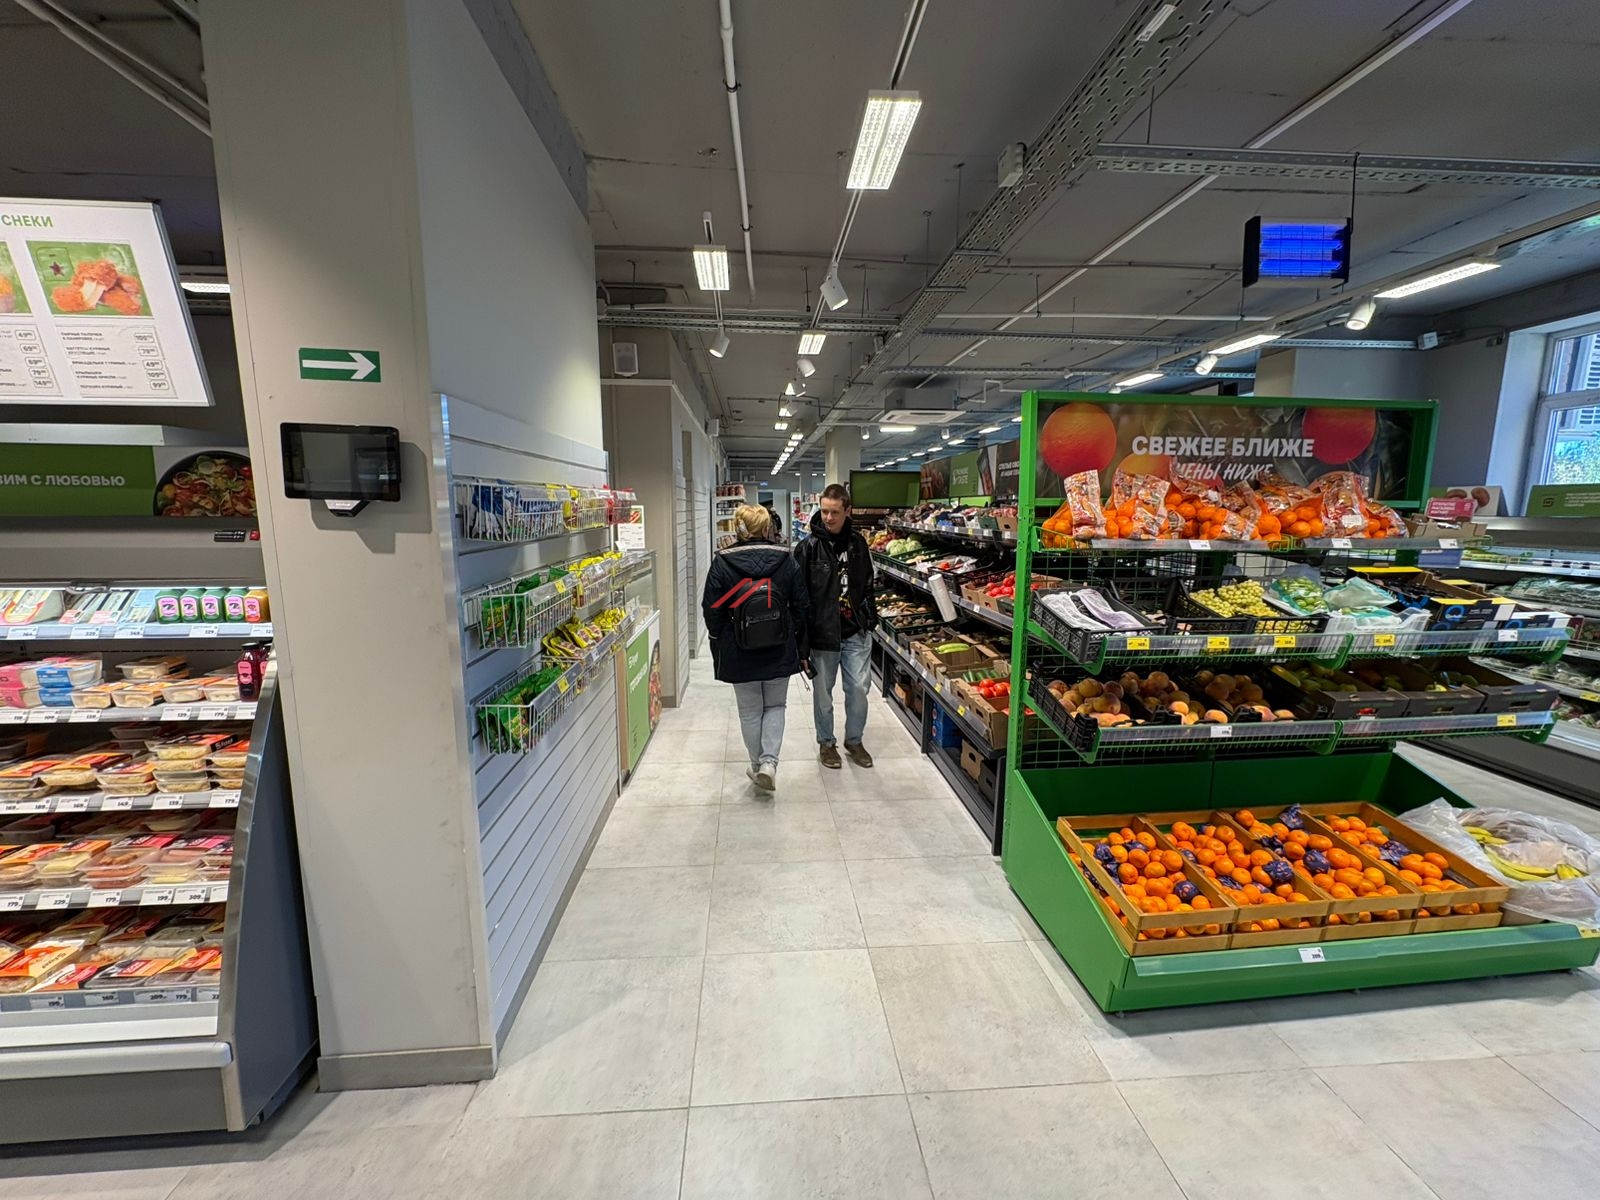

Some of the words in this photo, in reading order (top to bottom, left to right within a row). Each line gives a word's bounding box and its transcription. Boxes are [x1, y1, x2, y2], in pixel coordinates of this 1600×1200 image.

[1, 214, 54, 227] СНЕКИ
[1132, 436, 1226, 457] СВЕЖЕЕ
[1232, 437, 1315, 458] БЛИЖЕ
[1222, 463, 1273, 480] НИЖЕ
[31, 475, 42, 485] С
[45, 475, 126, 486] ЛЮБОВЬЮ
